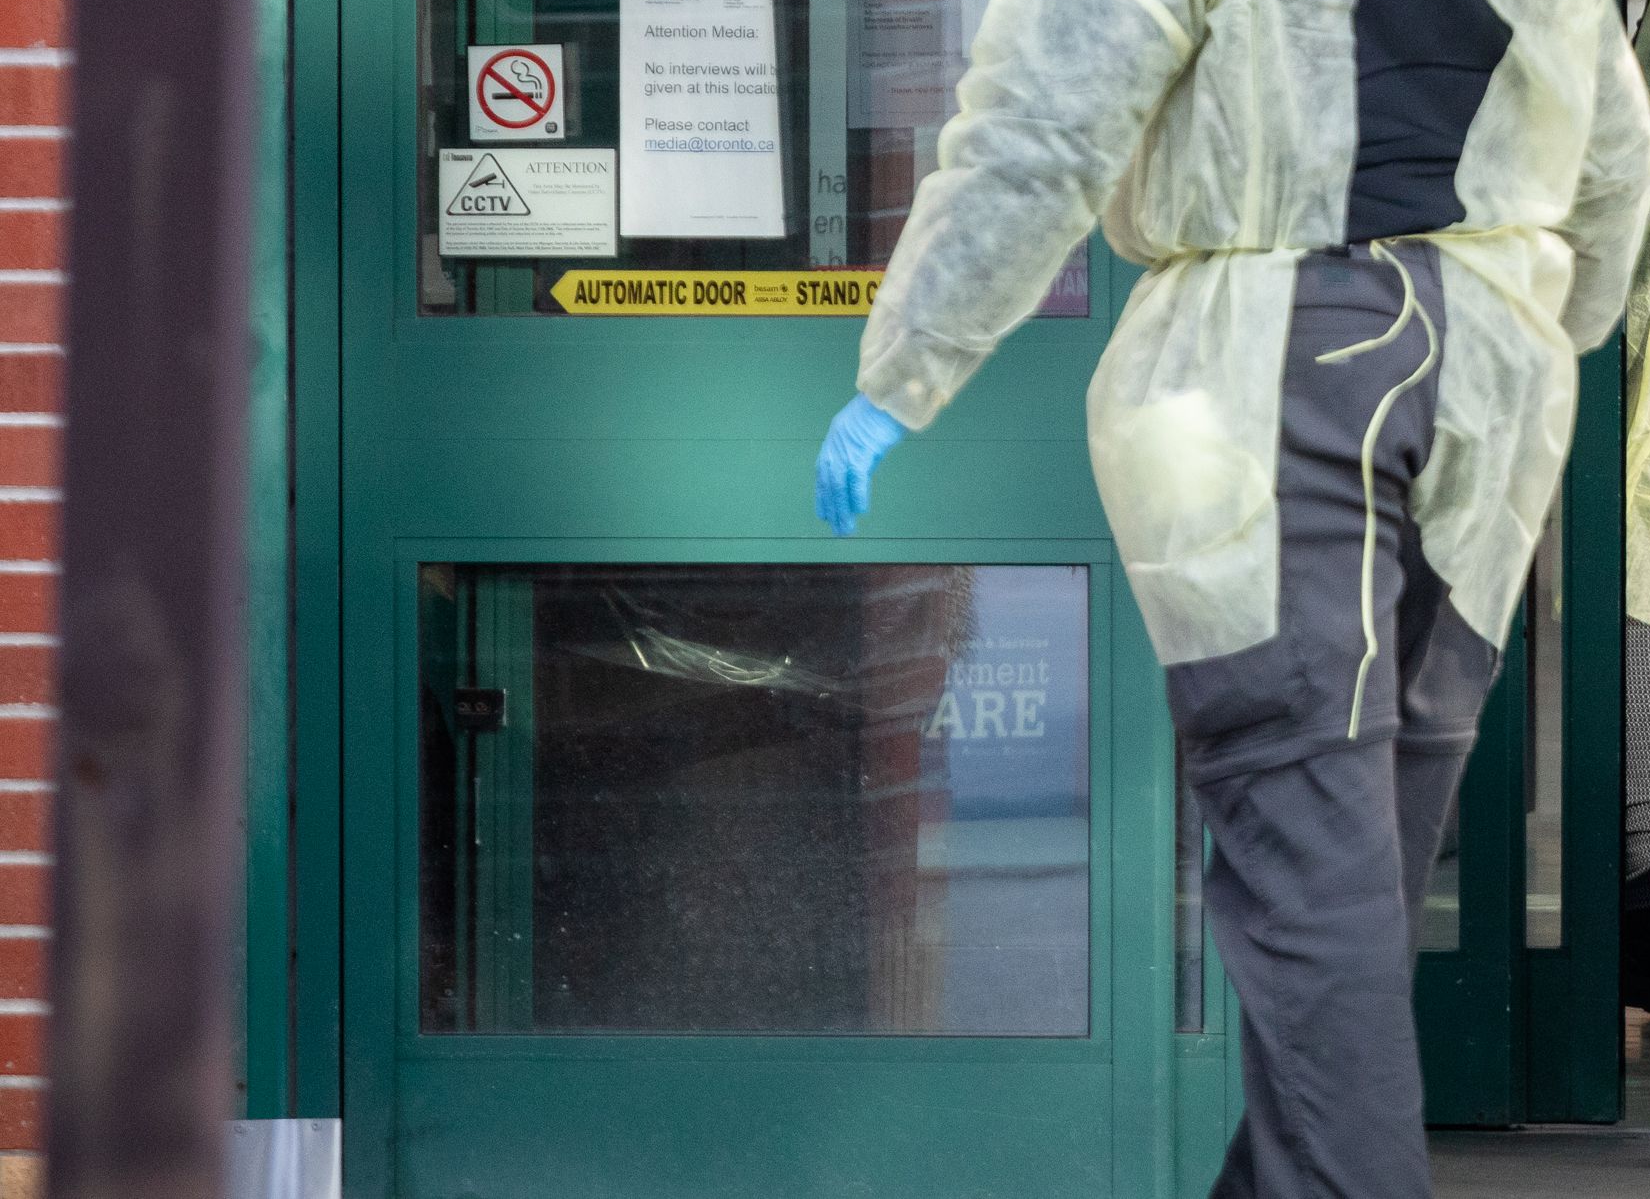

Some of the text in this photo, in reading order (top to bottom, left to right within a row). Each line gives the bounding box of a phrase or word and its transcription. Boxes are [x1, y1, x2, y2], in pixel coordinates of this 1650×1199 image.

[644, 25, 759, 39] Attention Media:
[644, 62, 664, 75] No
[669, 62, 740, 75] interviews
[744, 63, 766, 75] will
[644, 82, 682, 96] given
[687, 83, 700, 94] at
[704, 81, 729, 94] this
[644, 118, 750, 132] Please contact
[644, 137, 775, 152] media@toronto.ca
[525, 161, 608, 174] ATTENTION
[460, 195, 512, 212] CCTV
[574, 279, 747, 305] AUTOMATIC DOOR
[754, 283, 780, 293] besam
[795, 280, 860, 306] STAND
[921, 690, 1047, 739] ARE
